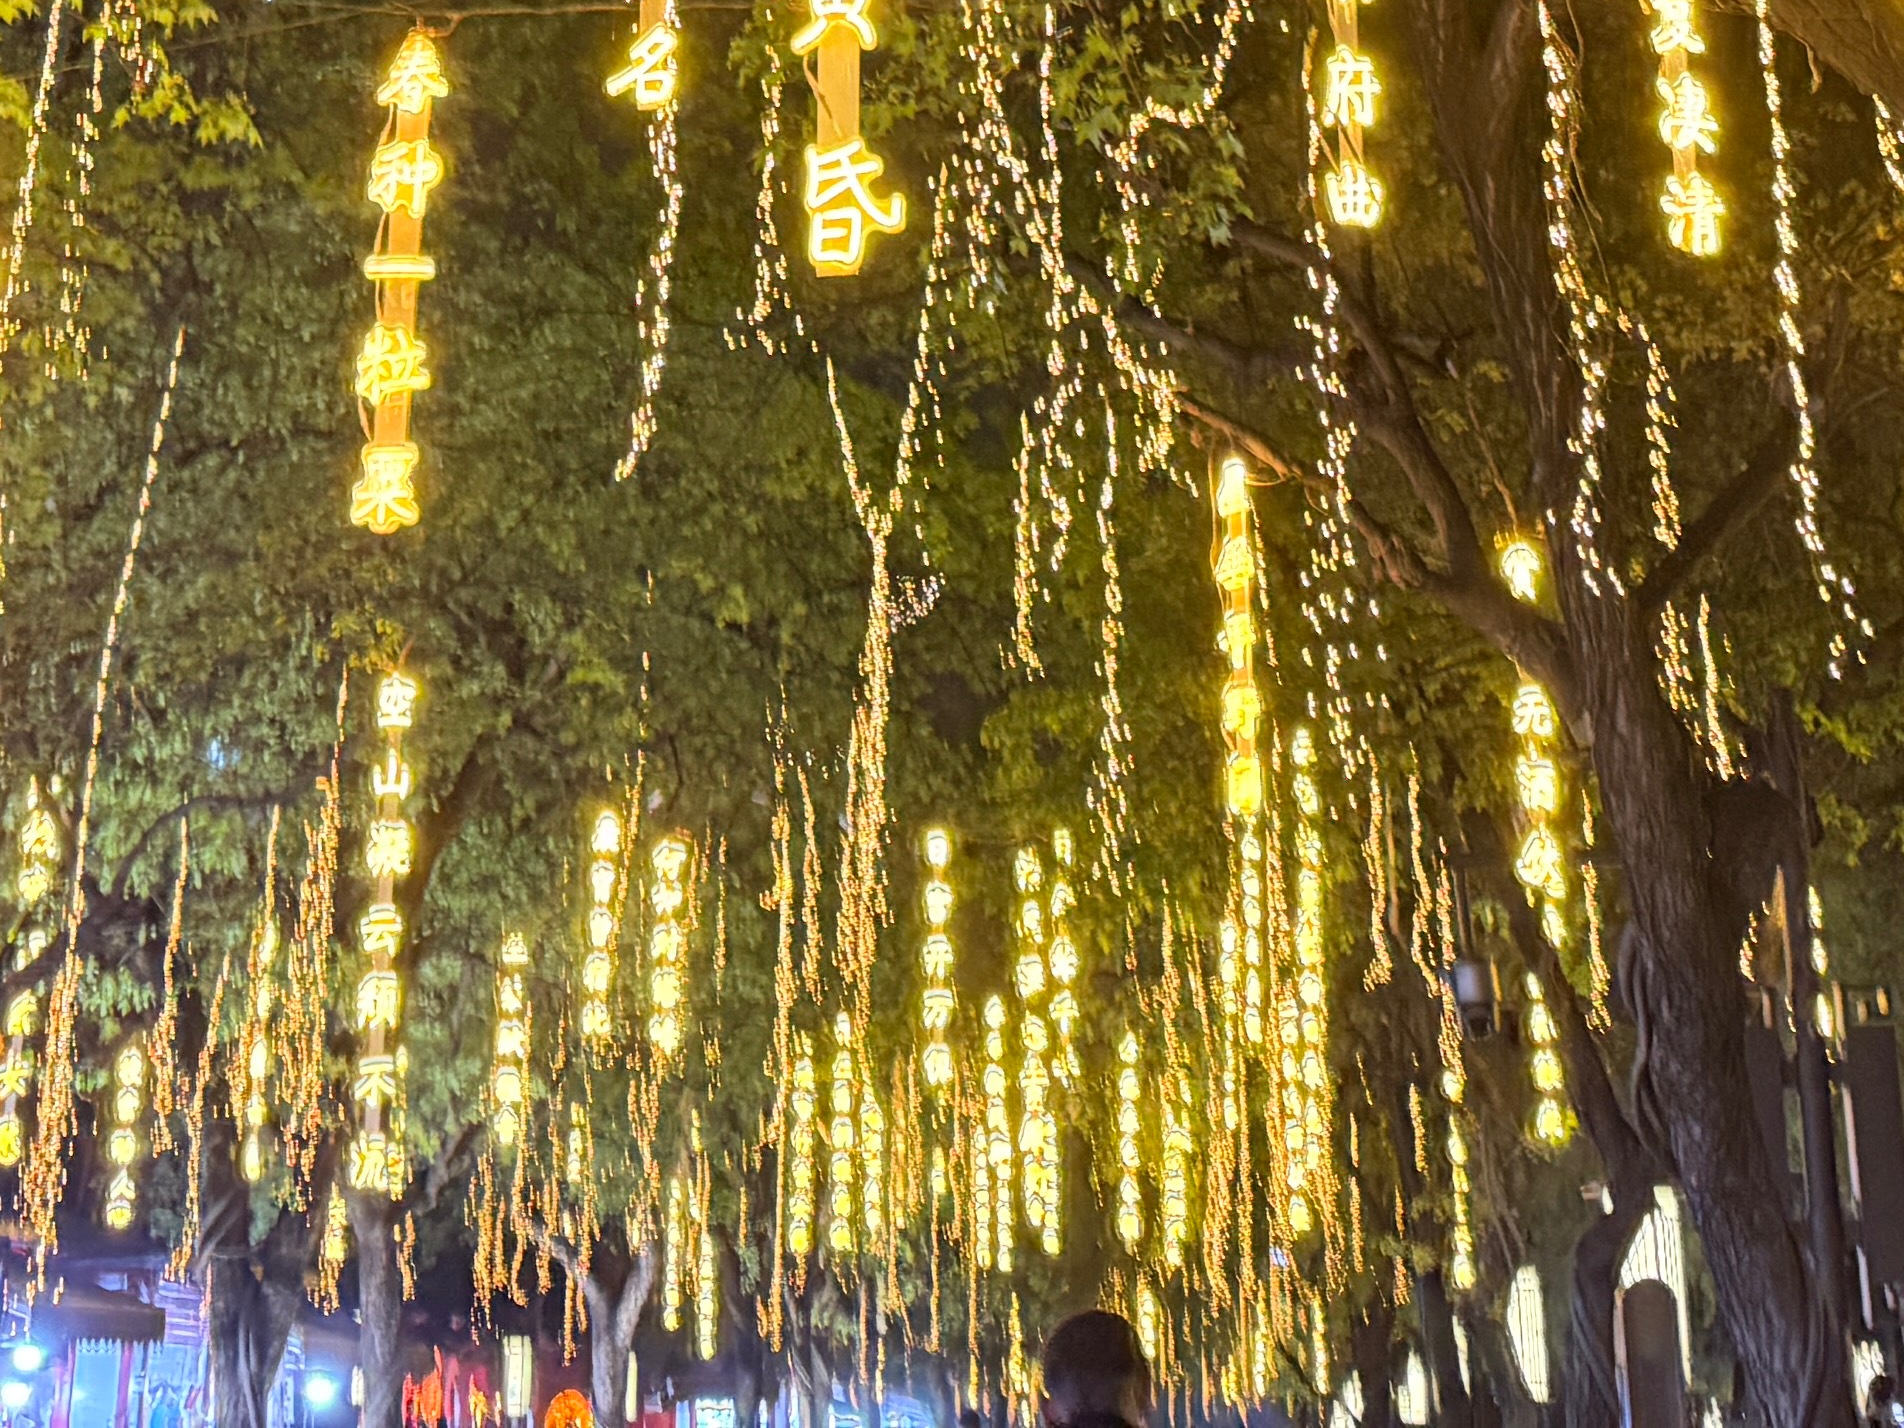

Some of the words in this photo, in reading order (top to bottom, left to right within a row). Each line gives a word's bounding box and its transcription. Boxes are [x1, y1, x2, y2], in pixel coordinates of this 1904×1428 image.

[350, 28, 450, 535] 春种一粒粟
